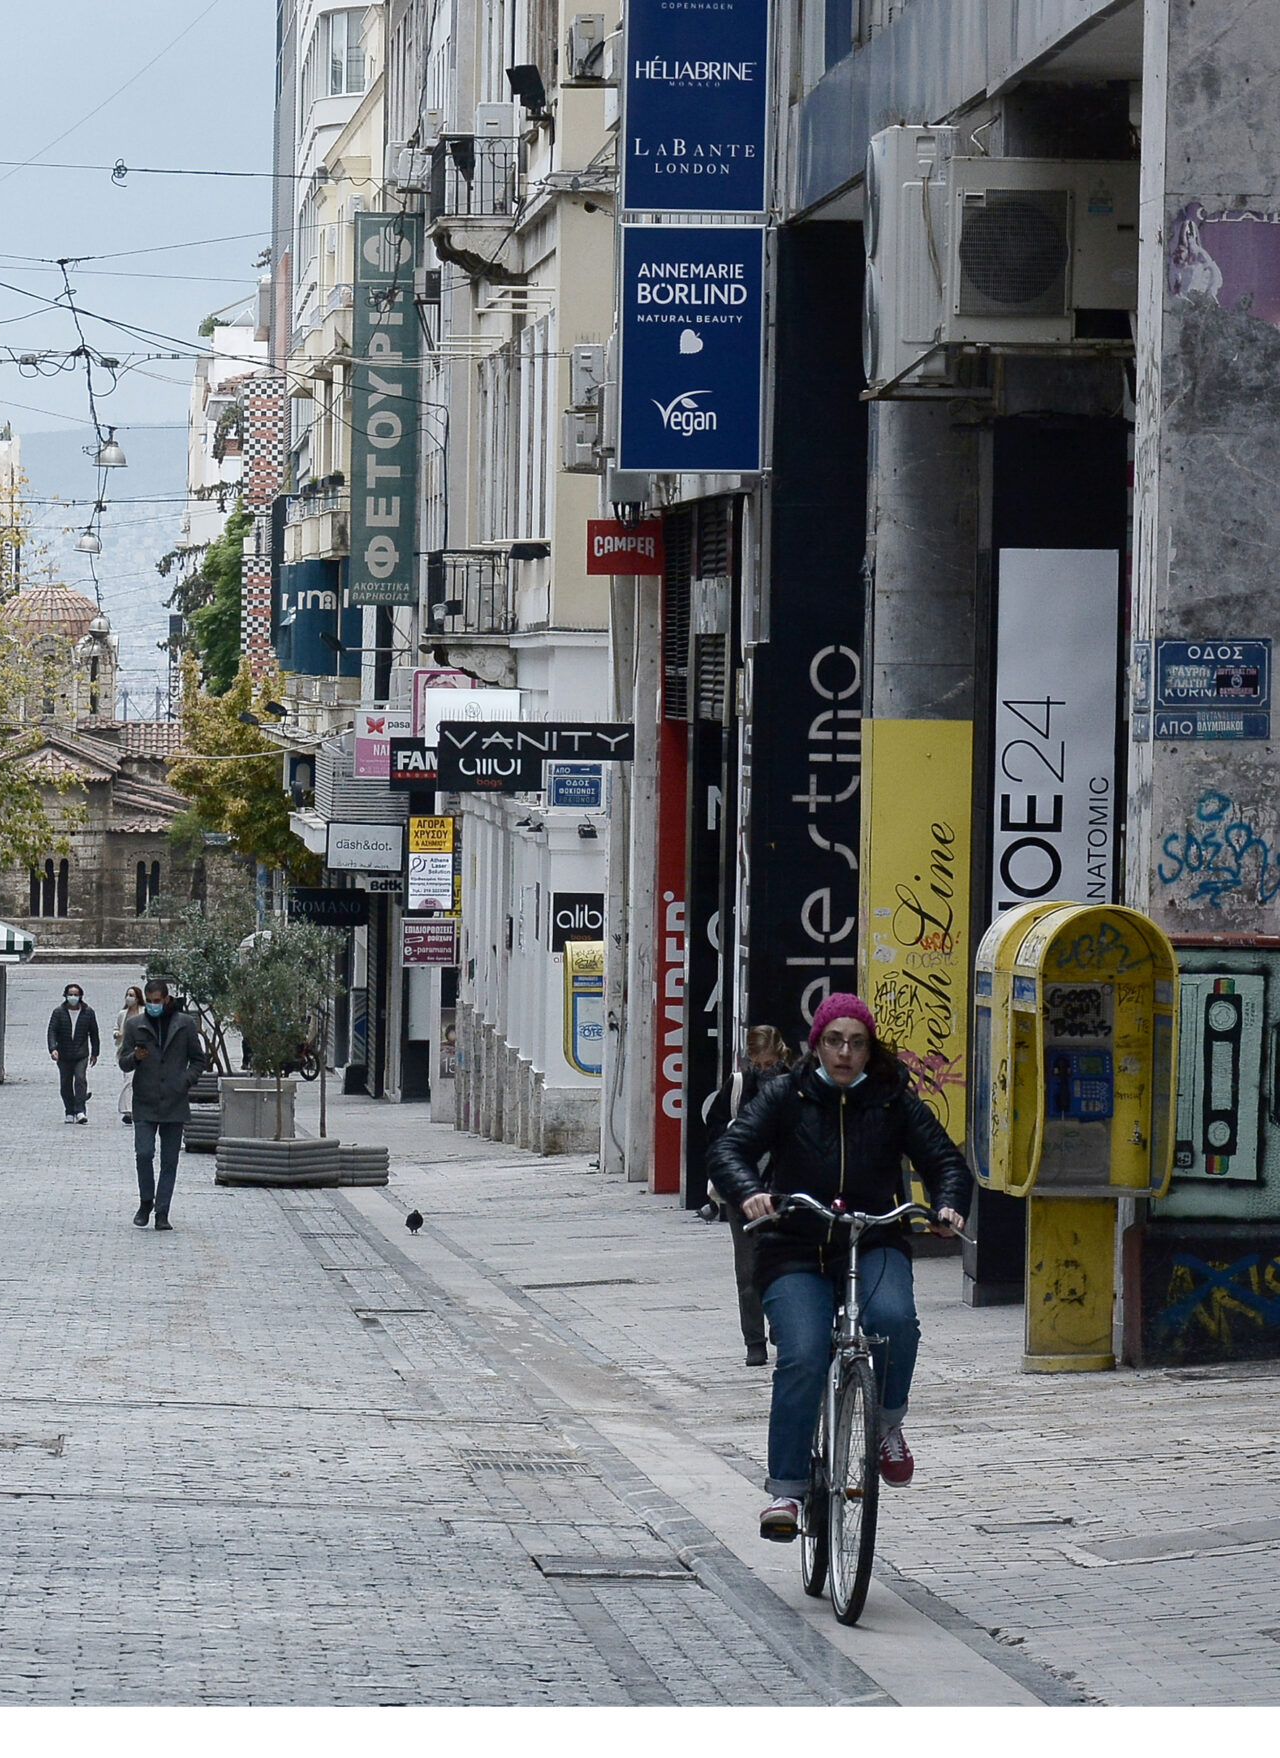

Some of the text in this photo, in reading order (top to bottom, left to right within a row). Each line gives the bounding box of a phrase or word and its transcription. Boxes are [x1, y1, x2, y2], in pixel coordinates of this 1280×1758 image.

[661, 2, 733, 10] COPENHAGEN
[634, 55, 754, 81] HÉLIABRINE
[655, 163, 730, 174] LONDON
[637, 263, 744, 279] ANNEMARIE
[637, 283, 747, 305] BÖRLIND
[637, 314, 743, 324] NATURAL BEAUTY
[650, 390, 717, 436] Vegan
[593, 535, 655, 559] CAMPER
[1187, 645, 1243, 659] ΟΔΟΣ
[1160, 721, 1193, 735] ΑΠΟ
[444, 730, 630, 752] VANITY
[565, 779, 590, 787] ΟΔΟΣ
[998, 696, 1066, 911] OE24
[416, 819, 446, 829] ΑΓΟΡΑ
[413, 829, 448, 839] ΧΡΥΣΟΥ
[1086, 776, 1109, 905] NATOMIC
[291, 900, 361, 913] ROMANO
